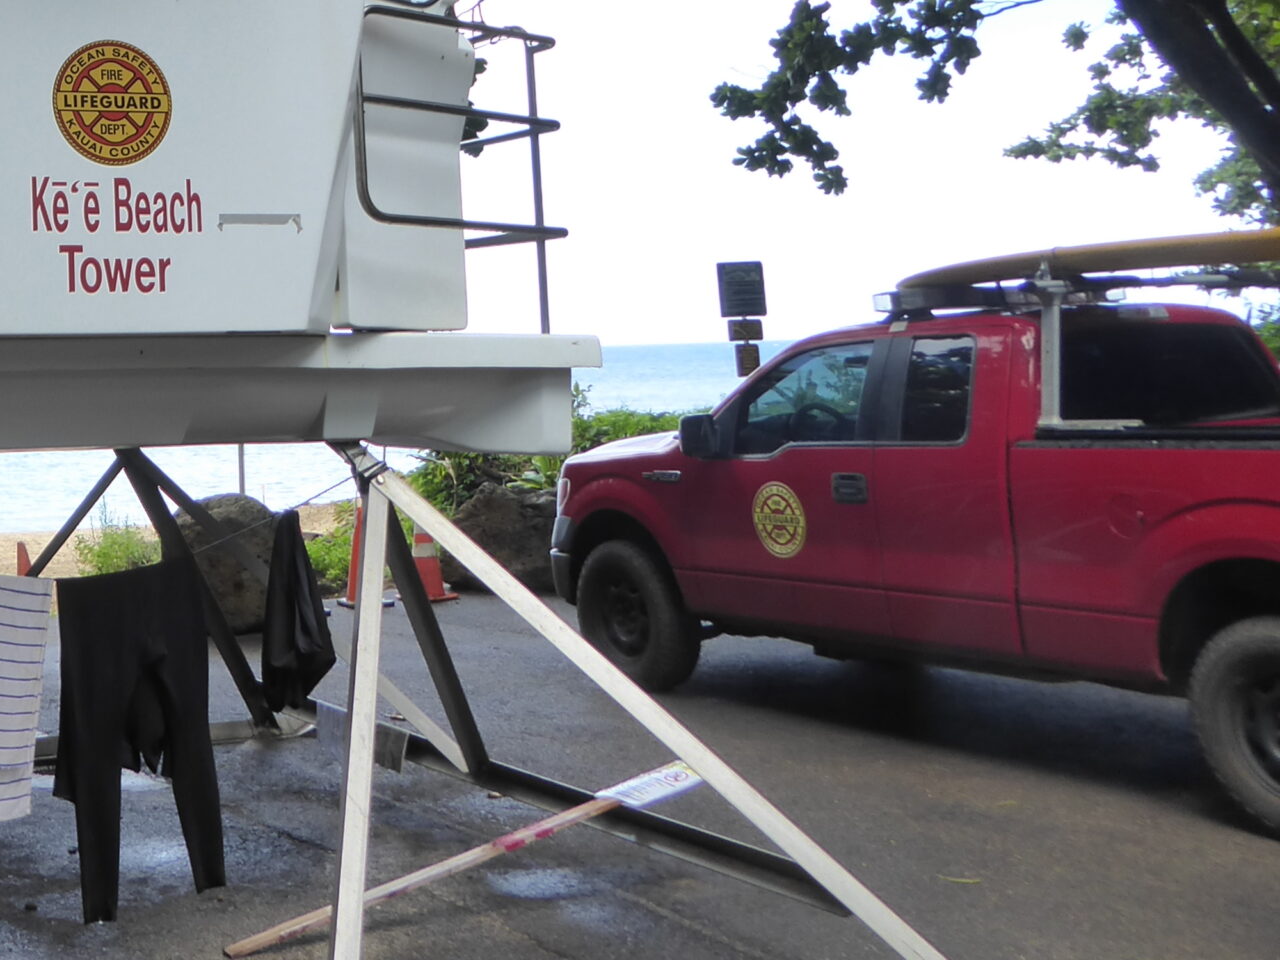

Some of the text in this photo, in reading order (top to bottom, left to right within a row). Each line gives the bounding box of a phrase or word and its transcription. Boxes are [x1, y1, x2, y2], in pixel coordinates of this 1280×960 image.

[64, 48, 160, 86] OCEAN SAFETY
[101, 69, 123, 81] FIRE
[63, 94, 162, 109] LIFEGUARD
[66, 118, 160, 157] KAUAI COUNTY
[113, 177, 203, 233] Beach
[58, 244, 172, 294] Tower
